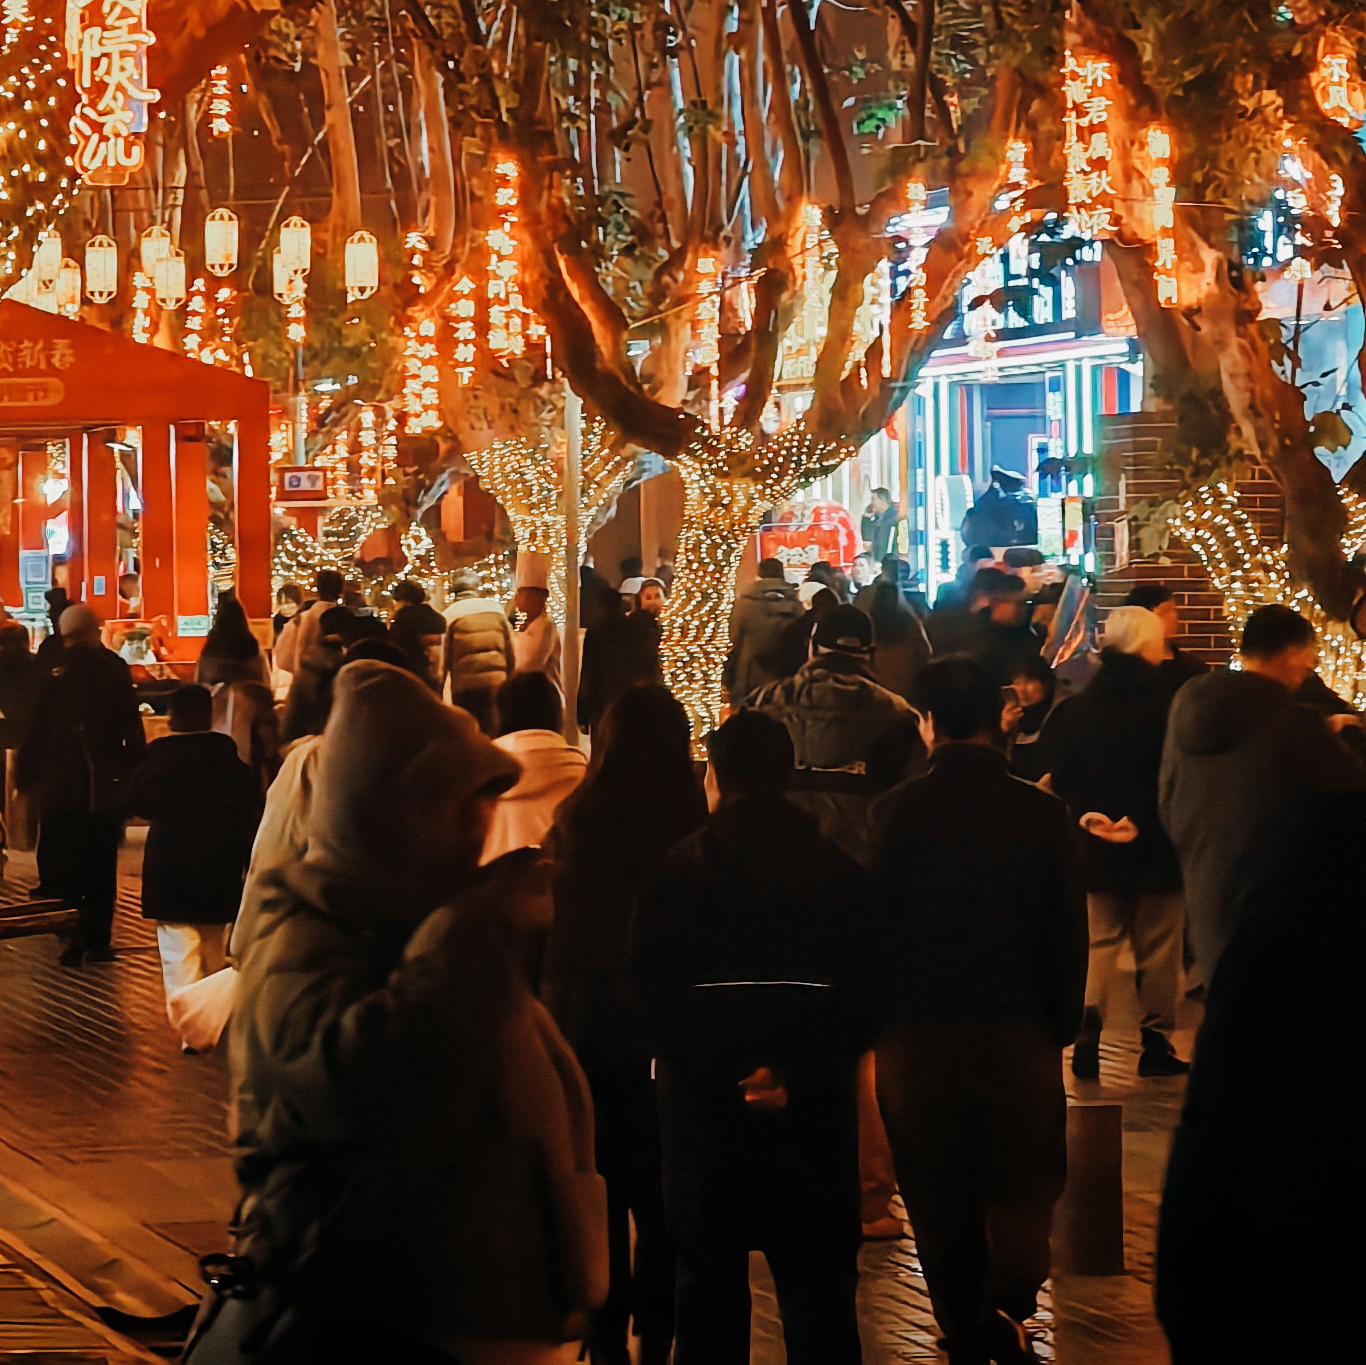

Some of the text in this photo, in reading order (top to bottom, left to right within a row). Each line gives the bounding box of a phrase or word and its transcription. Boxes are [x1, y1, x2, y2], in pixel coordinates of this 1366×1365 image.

[1082, 61, 1118, 233] 怀君属秋夜
